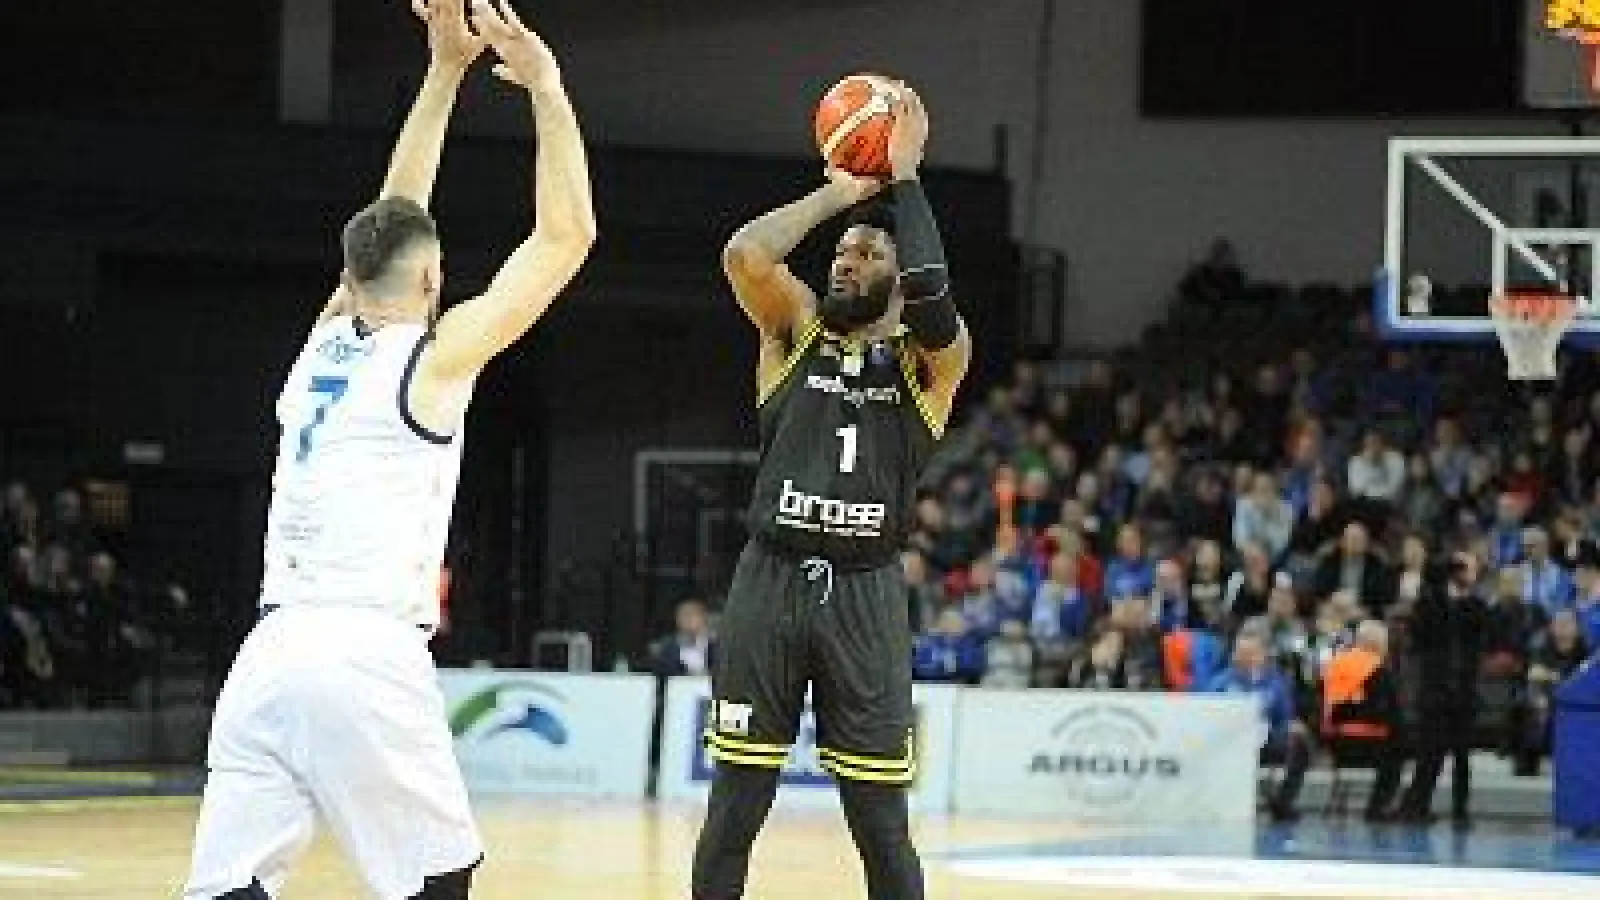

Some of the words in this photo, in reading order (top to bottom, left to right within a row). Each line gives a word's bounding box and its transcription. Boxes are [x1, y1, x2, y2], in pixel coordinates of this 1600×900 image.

[296, 376, 349, 462] 7
[836, 424, 857, 472] 1
[780, 480, 885, 525] brose
[1027, 753, 1182, 779] ARGUS
